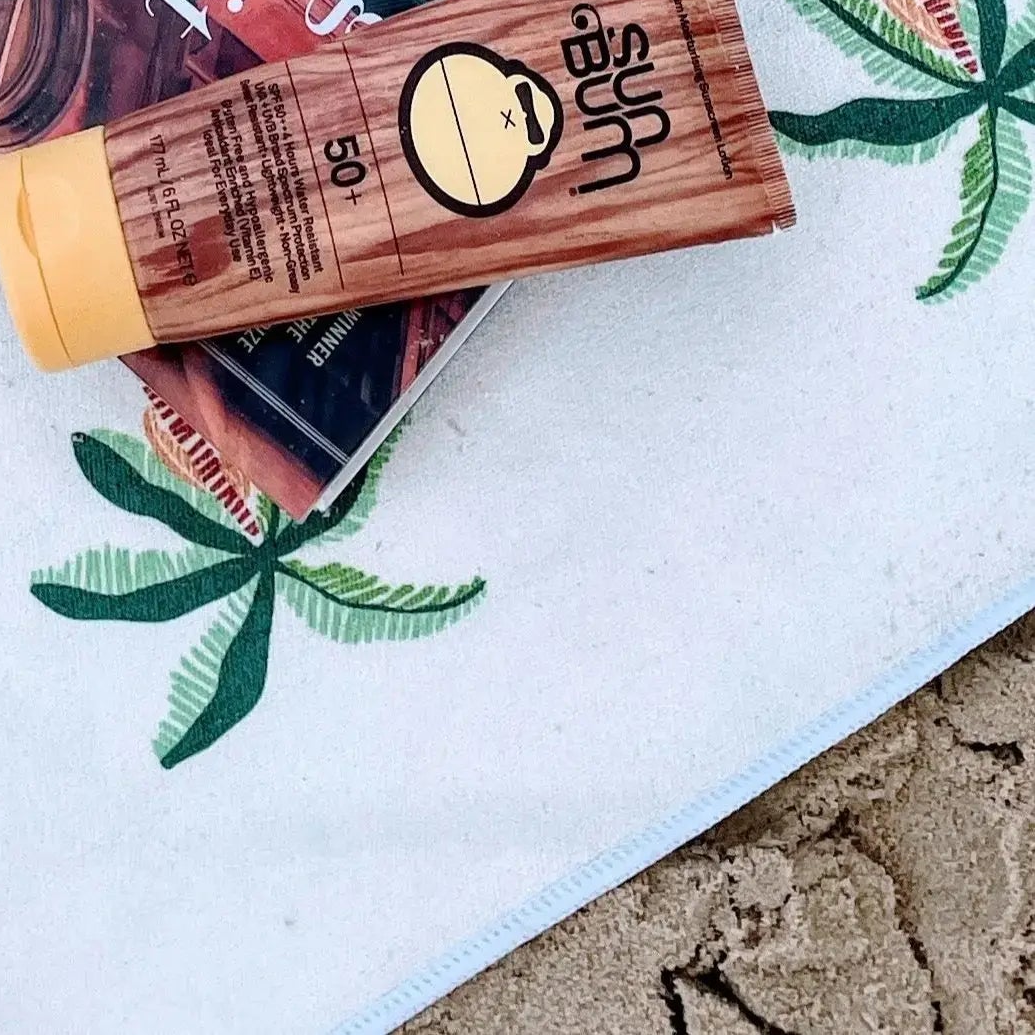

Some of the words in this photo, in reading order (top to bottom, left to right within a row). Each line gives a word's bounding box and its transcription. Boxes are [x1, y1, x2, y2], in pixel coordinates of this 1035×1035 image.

[148, 134, 165, 156] 177
[201, 129, 217, 157] Ideal
[699, 82, 722, 142] Sunscreen
[716, 143, 733, 180] Lotion
[153, 156, 172, 180] mL
[162, 186, 176, 197] 6
[209, 158, 223, 179] For
[267, 82, 281, 104] SPF
[284, 142, 300, 177] Hours
[293, 178, 309, 215] Water
[302, 217, 323, 273] Resistant
[322, 134, 367, 205] 50+
[164, 198, 181, 219] FL
[215, 181, 235, 237] Everyday
[225, 167, 245, 216] Enriched
[240, 218, 257, 266] (Vitamin
[230, 135, 246, 162] Free
[238, 164, 252, 188] and
[245, 191, 273, 283] Hypoallergenic
[247, 104, 267, 153] Resistant
[261, 159, 284, 226] Lightweight
[280, 233, 300, 294] Non-Greasy
[277, 167, 297, 223] Spectrum
[291, 225, 311, 280] Protection
[168, 217, 186, 240] OZ
[229, 239, 242, 262] Use
[306, 308, 362, 367] WINNER
